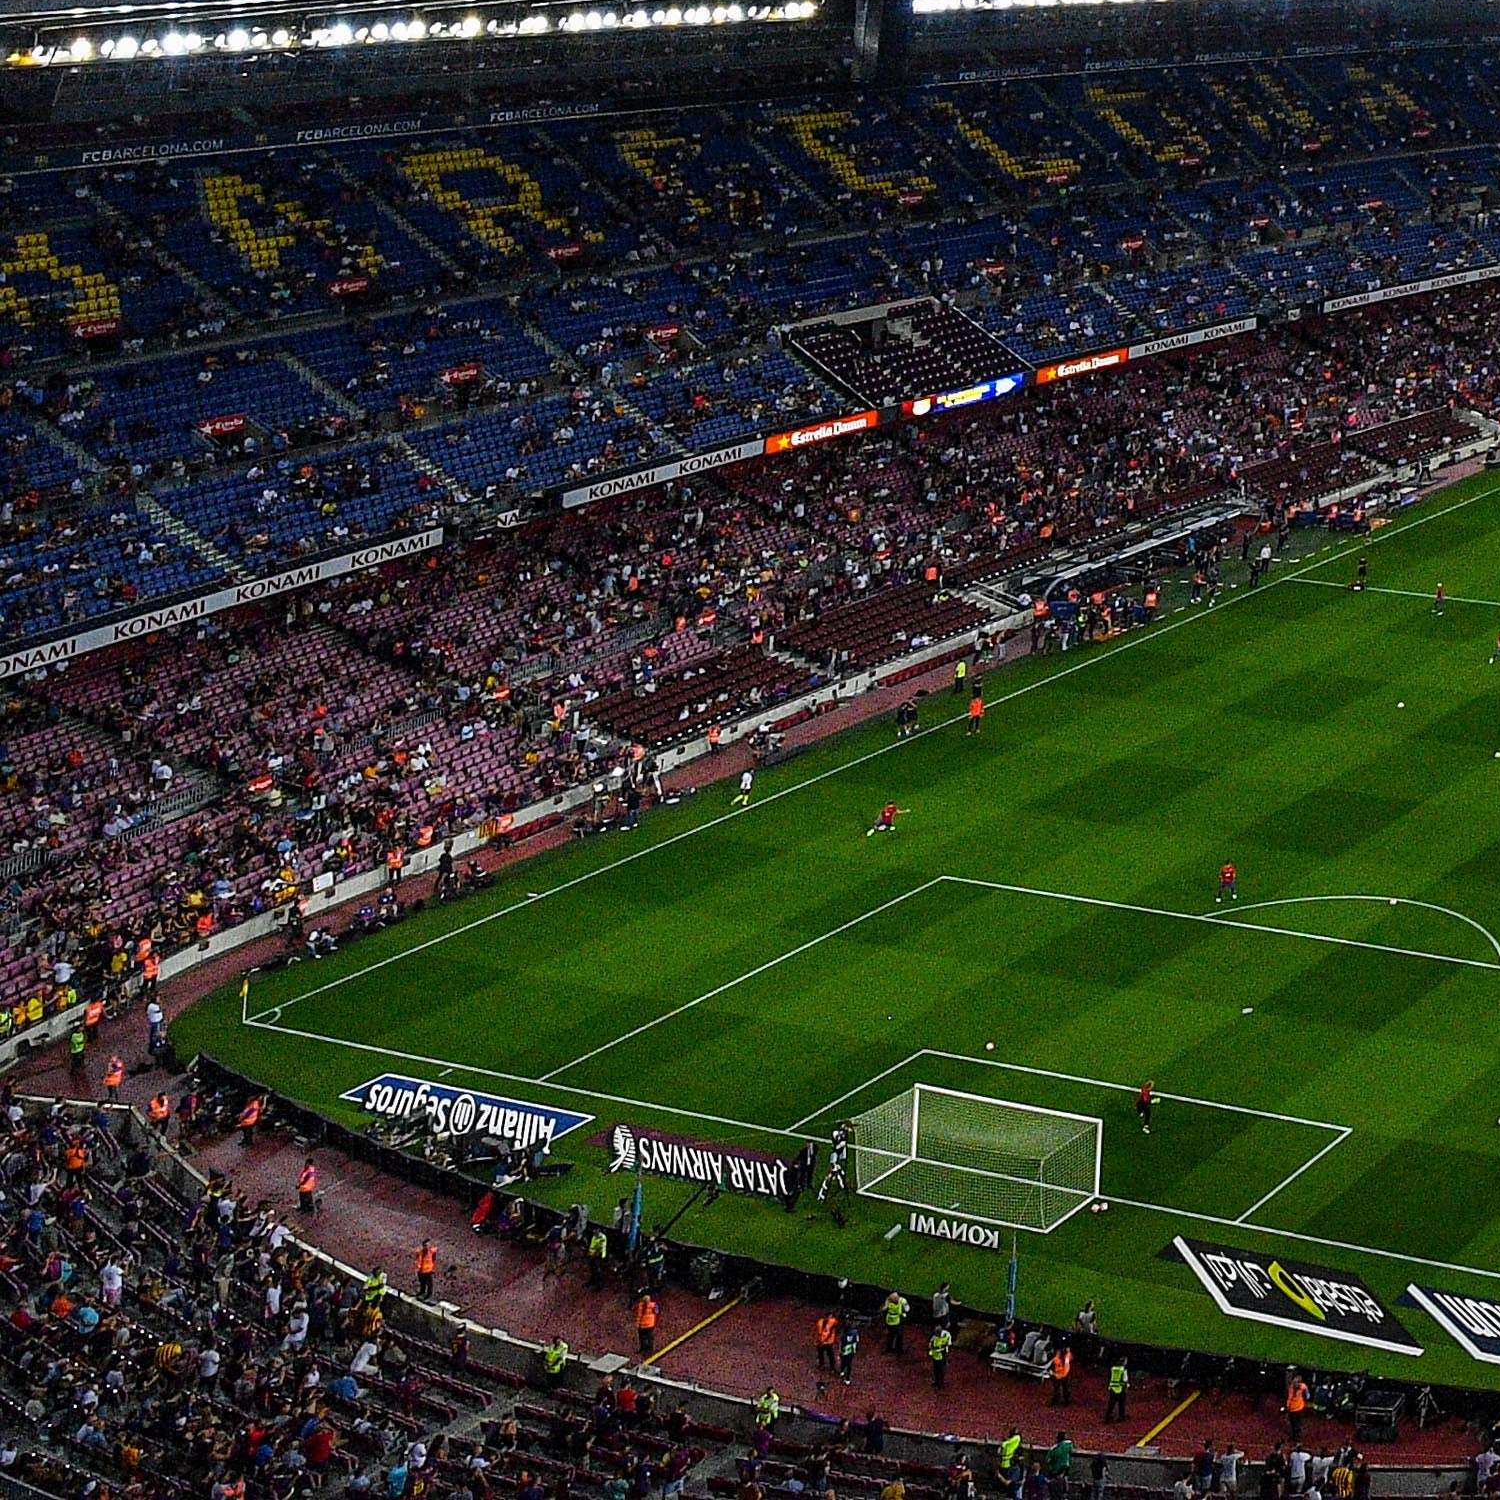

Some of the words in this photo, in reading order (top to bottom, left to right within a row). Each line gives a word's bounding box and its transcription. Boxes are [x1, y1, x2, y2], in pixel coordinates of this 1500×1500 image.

[490, 103, 600, 122] FCBARCELONA.COM
[296, 119, 421, 141] FCBARCELONA.COM
[81, 139, 224, 163] FCBARCELONA.COM
[1144, 334, 1189, 353] KONAMI
[1204, 322, 1247, 341] KONAMI
[791, 425, 833, 445] Estrella
[679, 447, 742, 474] KONAMI
[588, 471, 656, 500] KONAMI
[351, 534, 431, 569] KONAMI
[236, 566, 321, 602] KONAMI
[113, 600, 206, 641] KONAMI
[475, 1102, 557, 1154] Allianz
[638, 1137, 723, 1184] AIRWAYS
